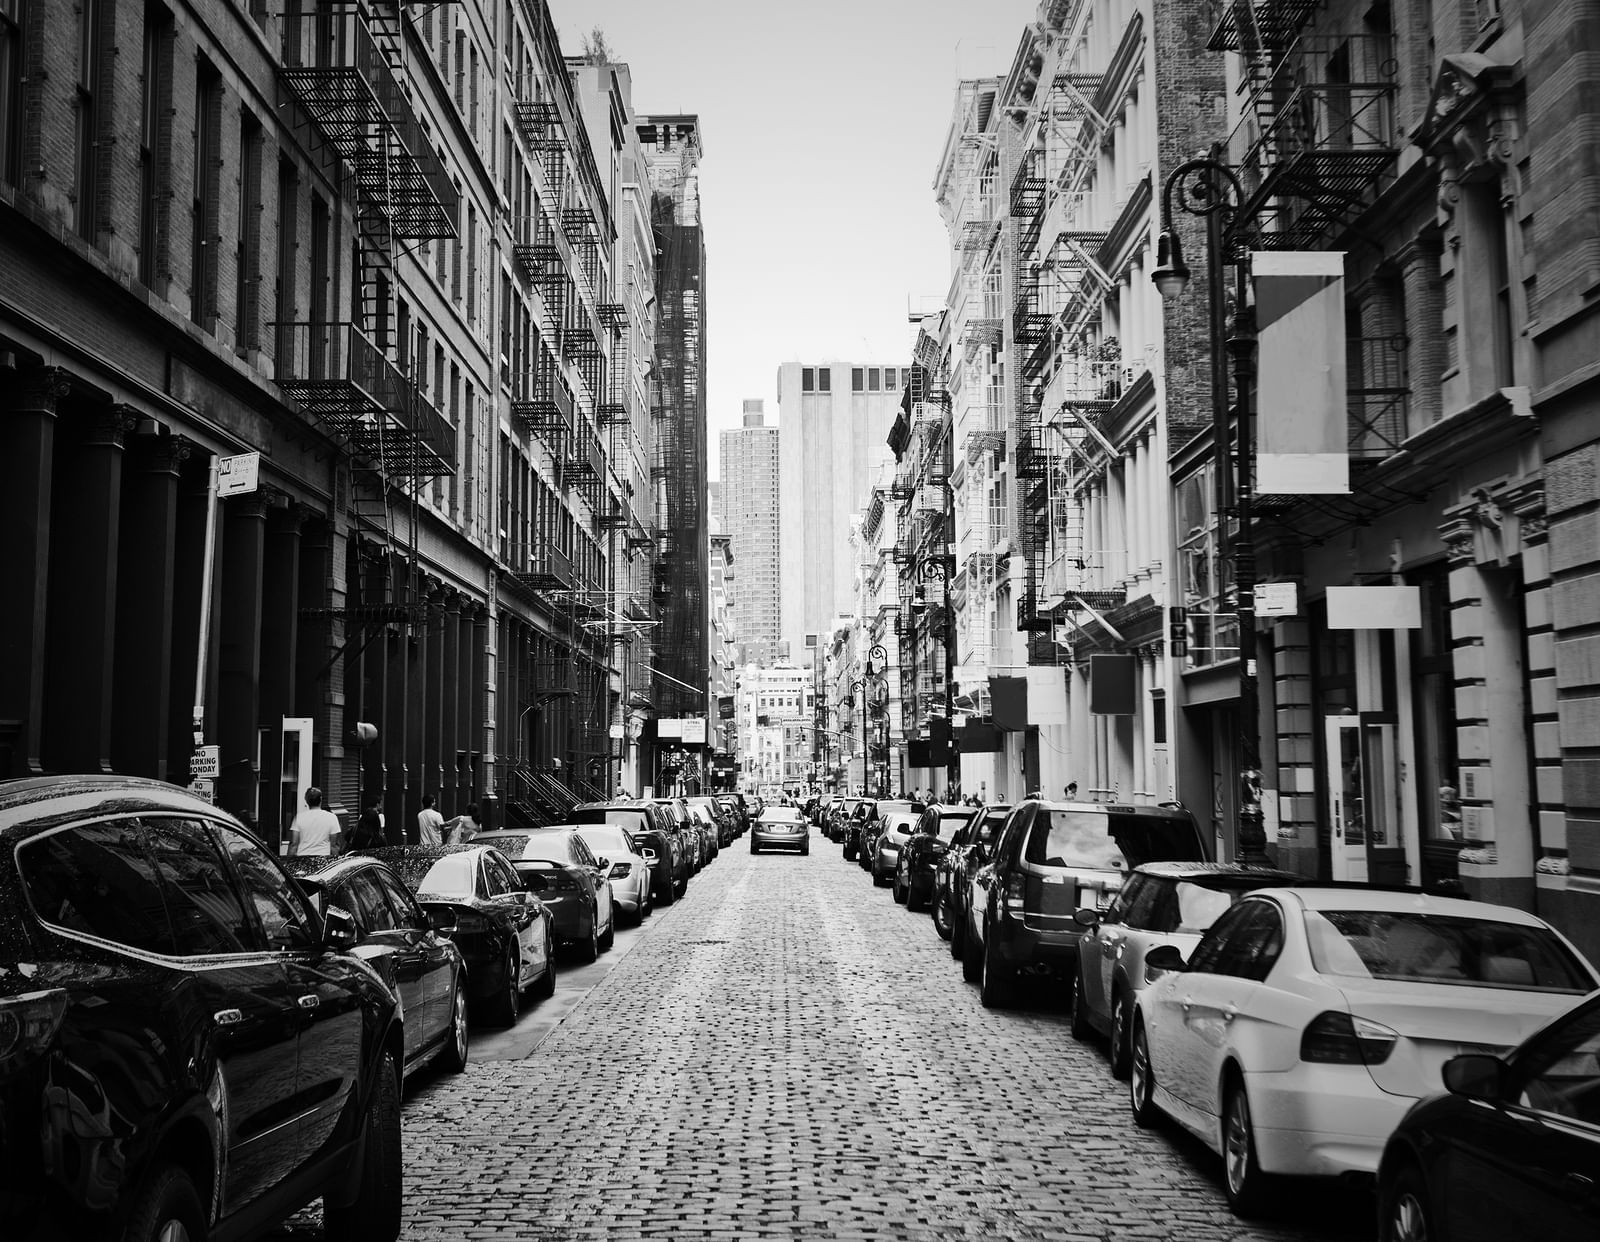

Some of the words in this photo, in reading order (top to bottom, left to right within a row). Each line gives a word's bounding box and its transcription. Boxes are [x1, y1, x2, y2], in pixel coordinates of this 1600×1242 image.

[220, 460, 231, 474] NO
[196, 750, 206, 758] NO
[191, 757, 216, 766] ARKING
[194, 782, 203, 790] NO
